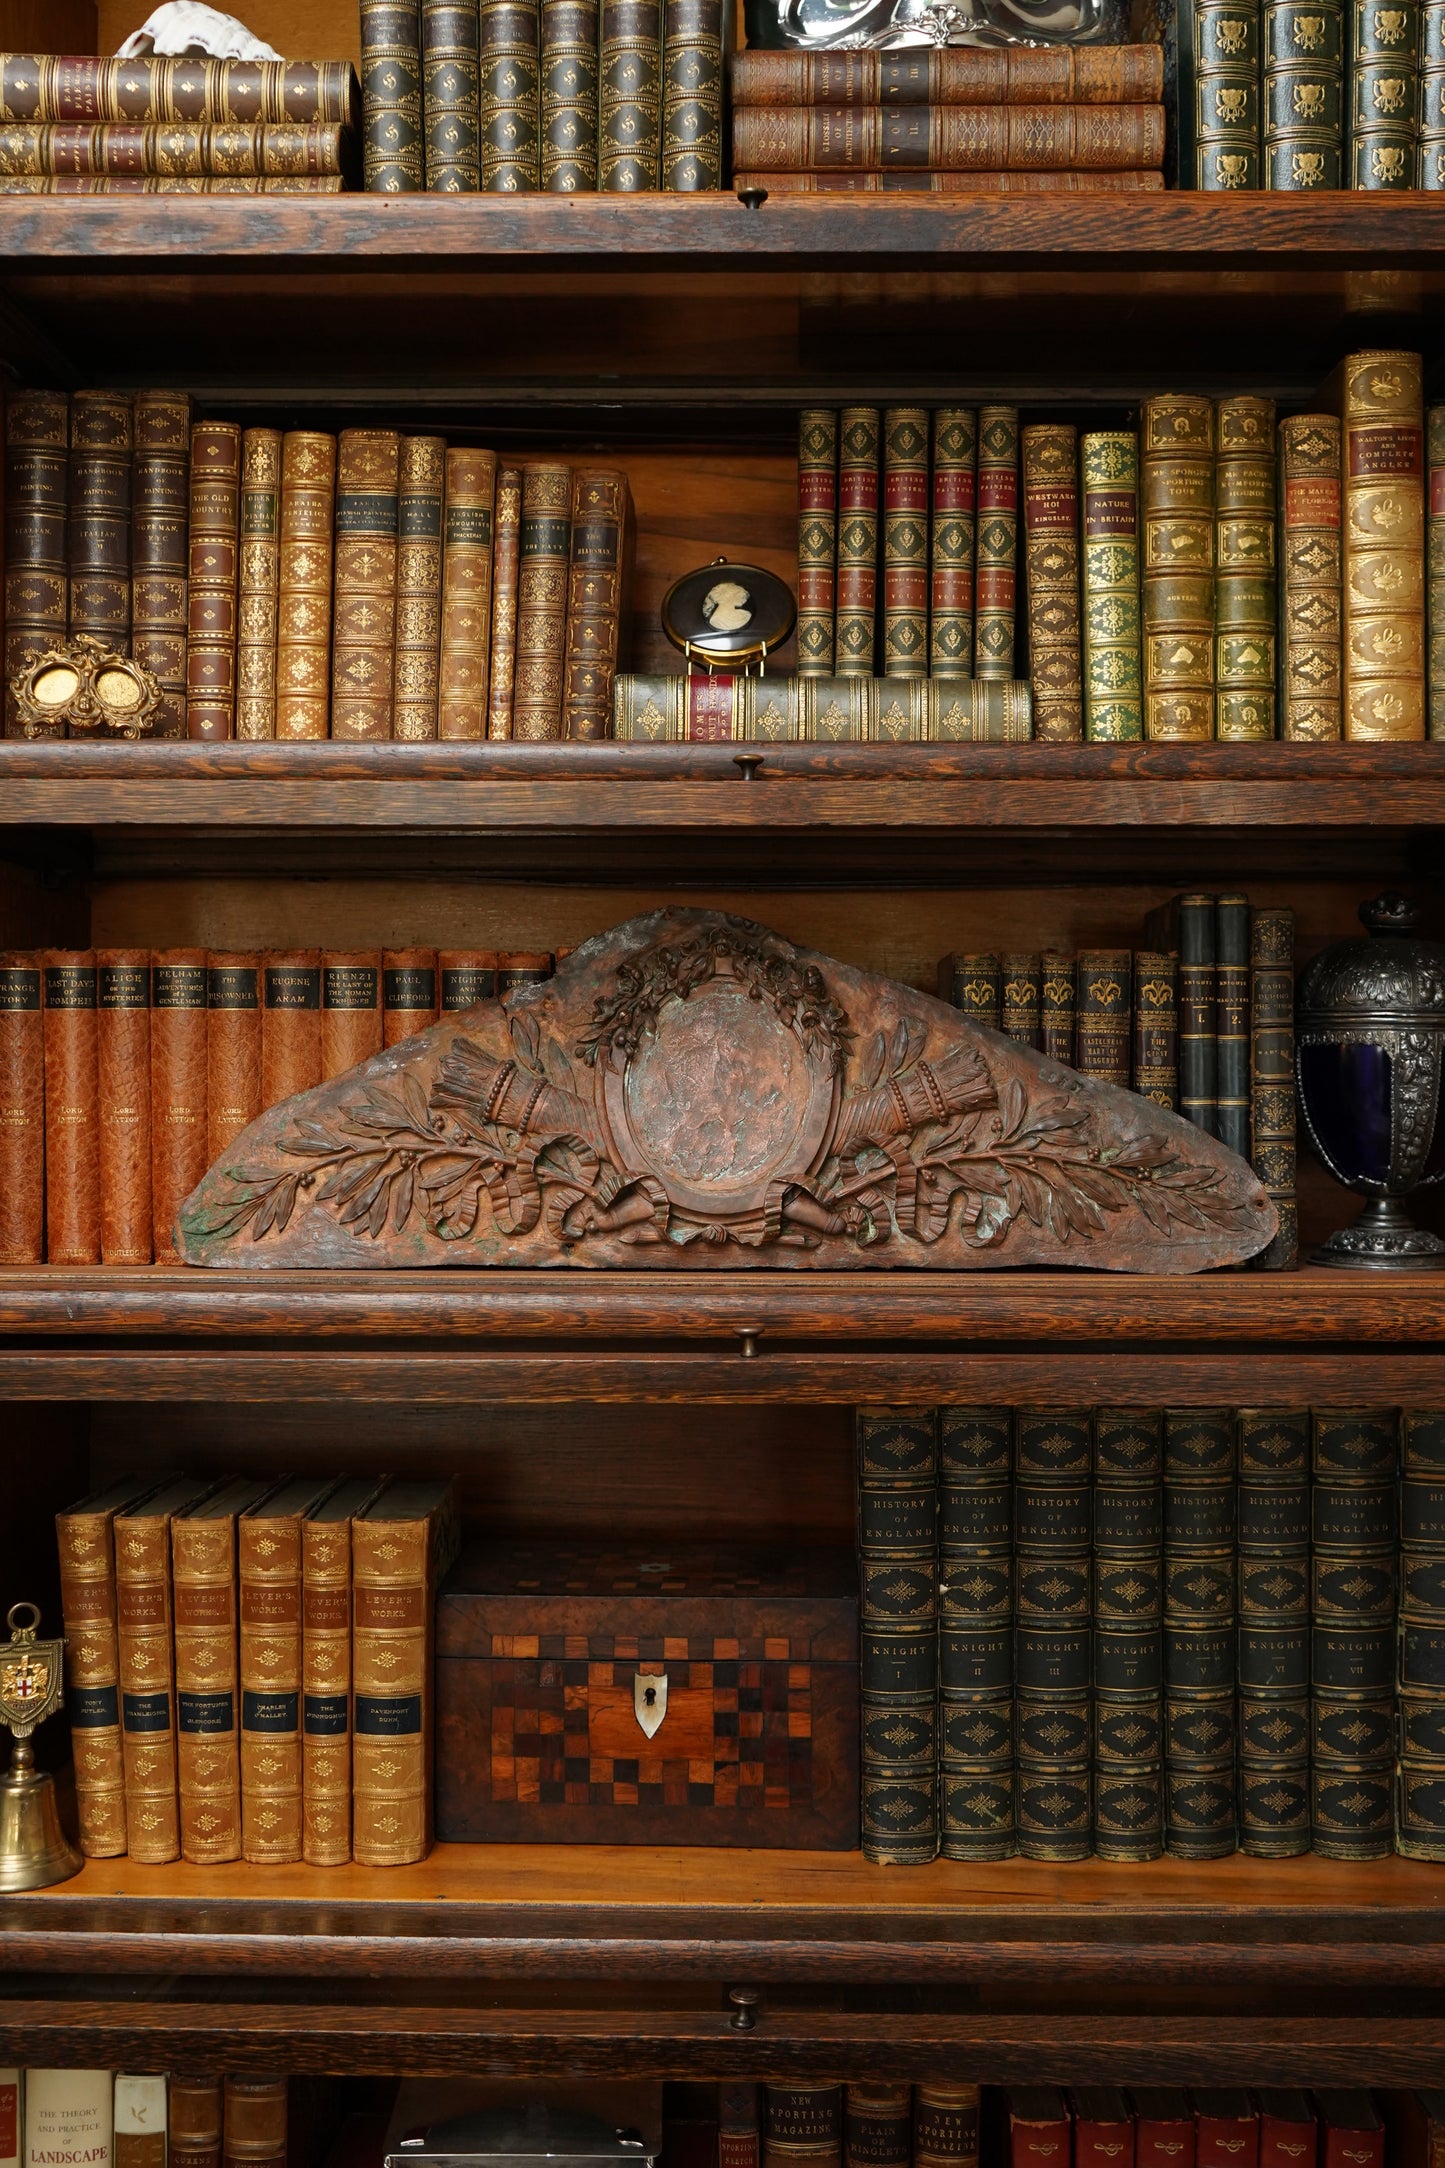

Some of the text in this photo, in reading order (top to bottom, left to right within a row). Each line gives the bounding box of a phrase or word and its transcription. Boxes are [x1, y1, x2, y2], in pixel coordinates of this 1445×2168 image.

[822, 55, 830, 96] GLOSSARY
[834, 69, 842, 80] OF
[64, 67, 72, 102] EARLY
[84, 60, 94, 113] PAINTERS
[822, 113, 830, 153] GLOSSARY
[834, 128, 842, 139] OF
[1359, 450, 1414, 458] COMPLETE
[14, 463, 60, 472] HANDBOOK
[138, 468, 184, 476] HANDBOOK
[77, 468, 124, 477] HANDBOOK
[844, 476, 876, 484] BRITISH
[194, 494, 230, 502] THE OLD
[192, 506, 233, 514] COUNTRY
[1100, 516, 1135, 524] BRITAIN
[105, 974, 142, 983] ALICE
[328, 972, 372, 980] RIENZI
[395, 976, 422, 984] PAUL
[450, 976, 485, 984] NIGHT
[48, 980, 95, 988] LAST DAYS
[272, 978, 310, 986] EUGENE
[50, 998, 94, 1006] POMPEII
[388, 994, 431, 1002] CLIFFORD
[1231, 1014, 1242, 1025] 2.
[1052, 1038, 1068, 1046] THE
[1150, 1038, 1168, 1046] THE
[873, 1500, 926, 1510] HISTORY
[951, 1496, 1004, 1505] HISTORY
[1027, 1498, 1080, 1507] HISTORY
[1102, 1498, 1155, 1508] HISTORY
[1173, 1496, 1226, 1506] HISTORY
[1250, 1496, 1302, 1506] HISTORY
[1330, 1496, 1384, 1506] HISTORY
[866, 1528, 932, 1538] ENGLAND
[944, 1524, 1009, 1534] ENGLAND
[1021, 1526, 1088, 1536] ENGLAND
[1096, 1526, 1161, 1536] ENGLAND
[1166, 1526, 1232, 1535] ENGLAND
[1242, 1525, 1308, 1534] ENGLAND
[1322, 1524, 1389, 1534] ENGLAND
[179, 1594, 226, 1604] LEVER'S
[246, 1592, 292, 1600] LEVER'S
[366, 1596, 412, 1604] LEVER'S
[123, 1608, 157, 1616] WORKS.
[951, 1642, 1005, 1652] KNIGHT
[1026, 1642, 1081, 1652] KNIGHT
[1174, 1642, 1228, 1652] KNIGHT
[1249, 1640, 1304, 1650] KNIGHT
[1327, 1641, 1382, 1651] KNIGHT
[872, 1646, 927, 1656] KNIGHT
[1102, 1646, 1156, 1655] KNIGHT
[974, 1668, 982, 1676] II
[1050, 1668, 1060, 1676] III
[1126, 1668, 1137, 1676] IV
[1200, 1667, 1208, 1675] V
[1350, 1666, 1364, 1674] VII
[791, 2096, 812, 2105] NEW
[61, 2108, 98, 2118] THEORY
[770, 2109, 833, 2120] SPORTING
[934, 2116, 962, 2126] NEW
[38, 2122, 102, 2133] AND PRACTICE
[774, 2124, 832, 2136] MAGAZINE
[860, 2128, 897, 2136] PLAIN
[918, 2126, 976, 2138] SPORTING
[872, 2138, 886, 2146] OR
[918, 2138, 976, 2151] MAGAZINE
[722, 2142, 756, 2152] SPORTING
[31, 2146, 108, 2164] LANDSCAPE
